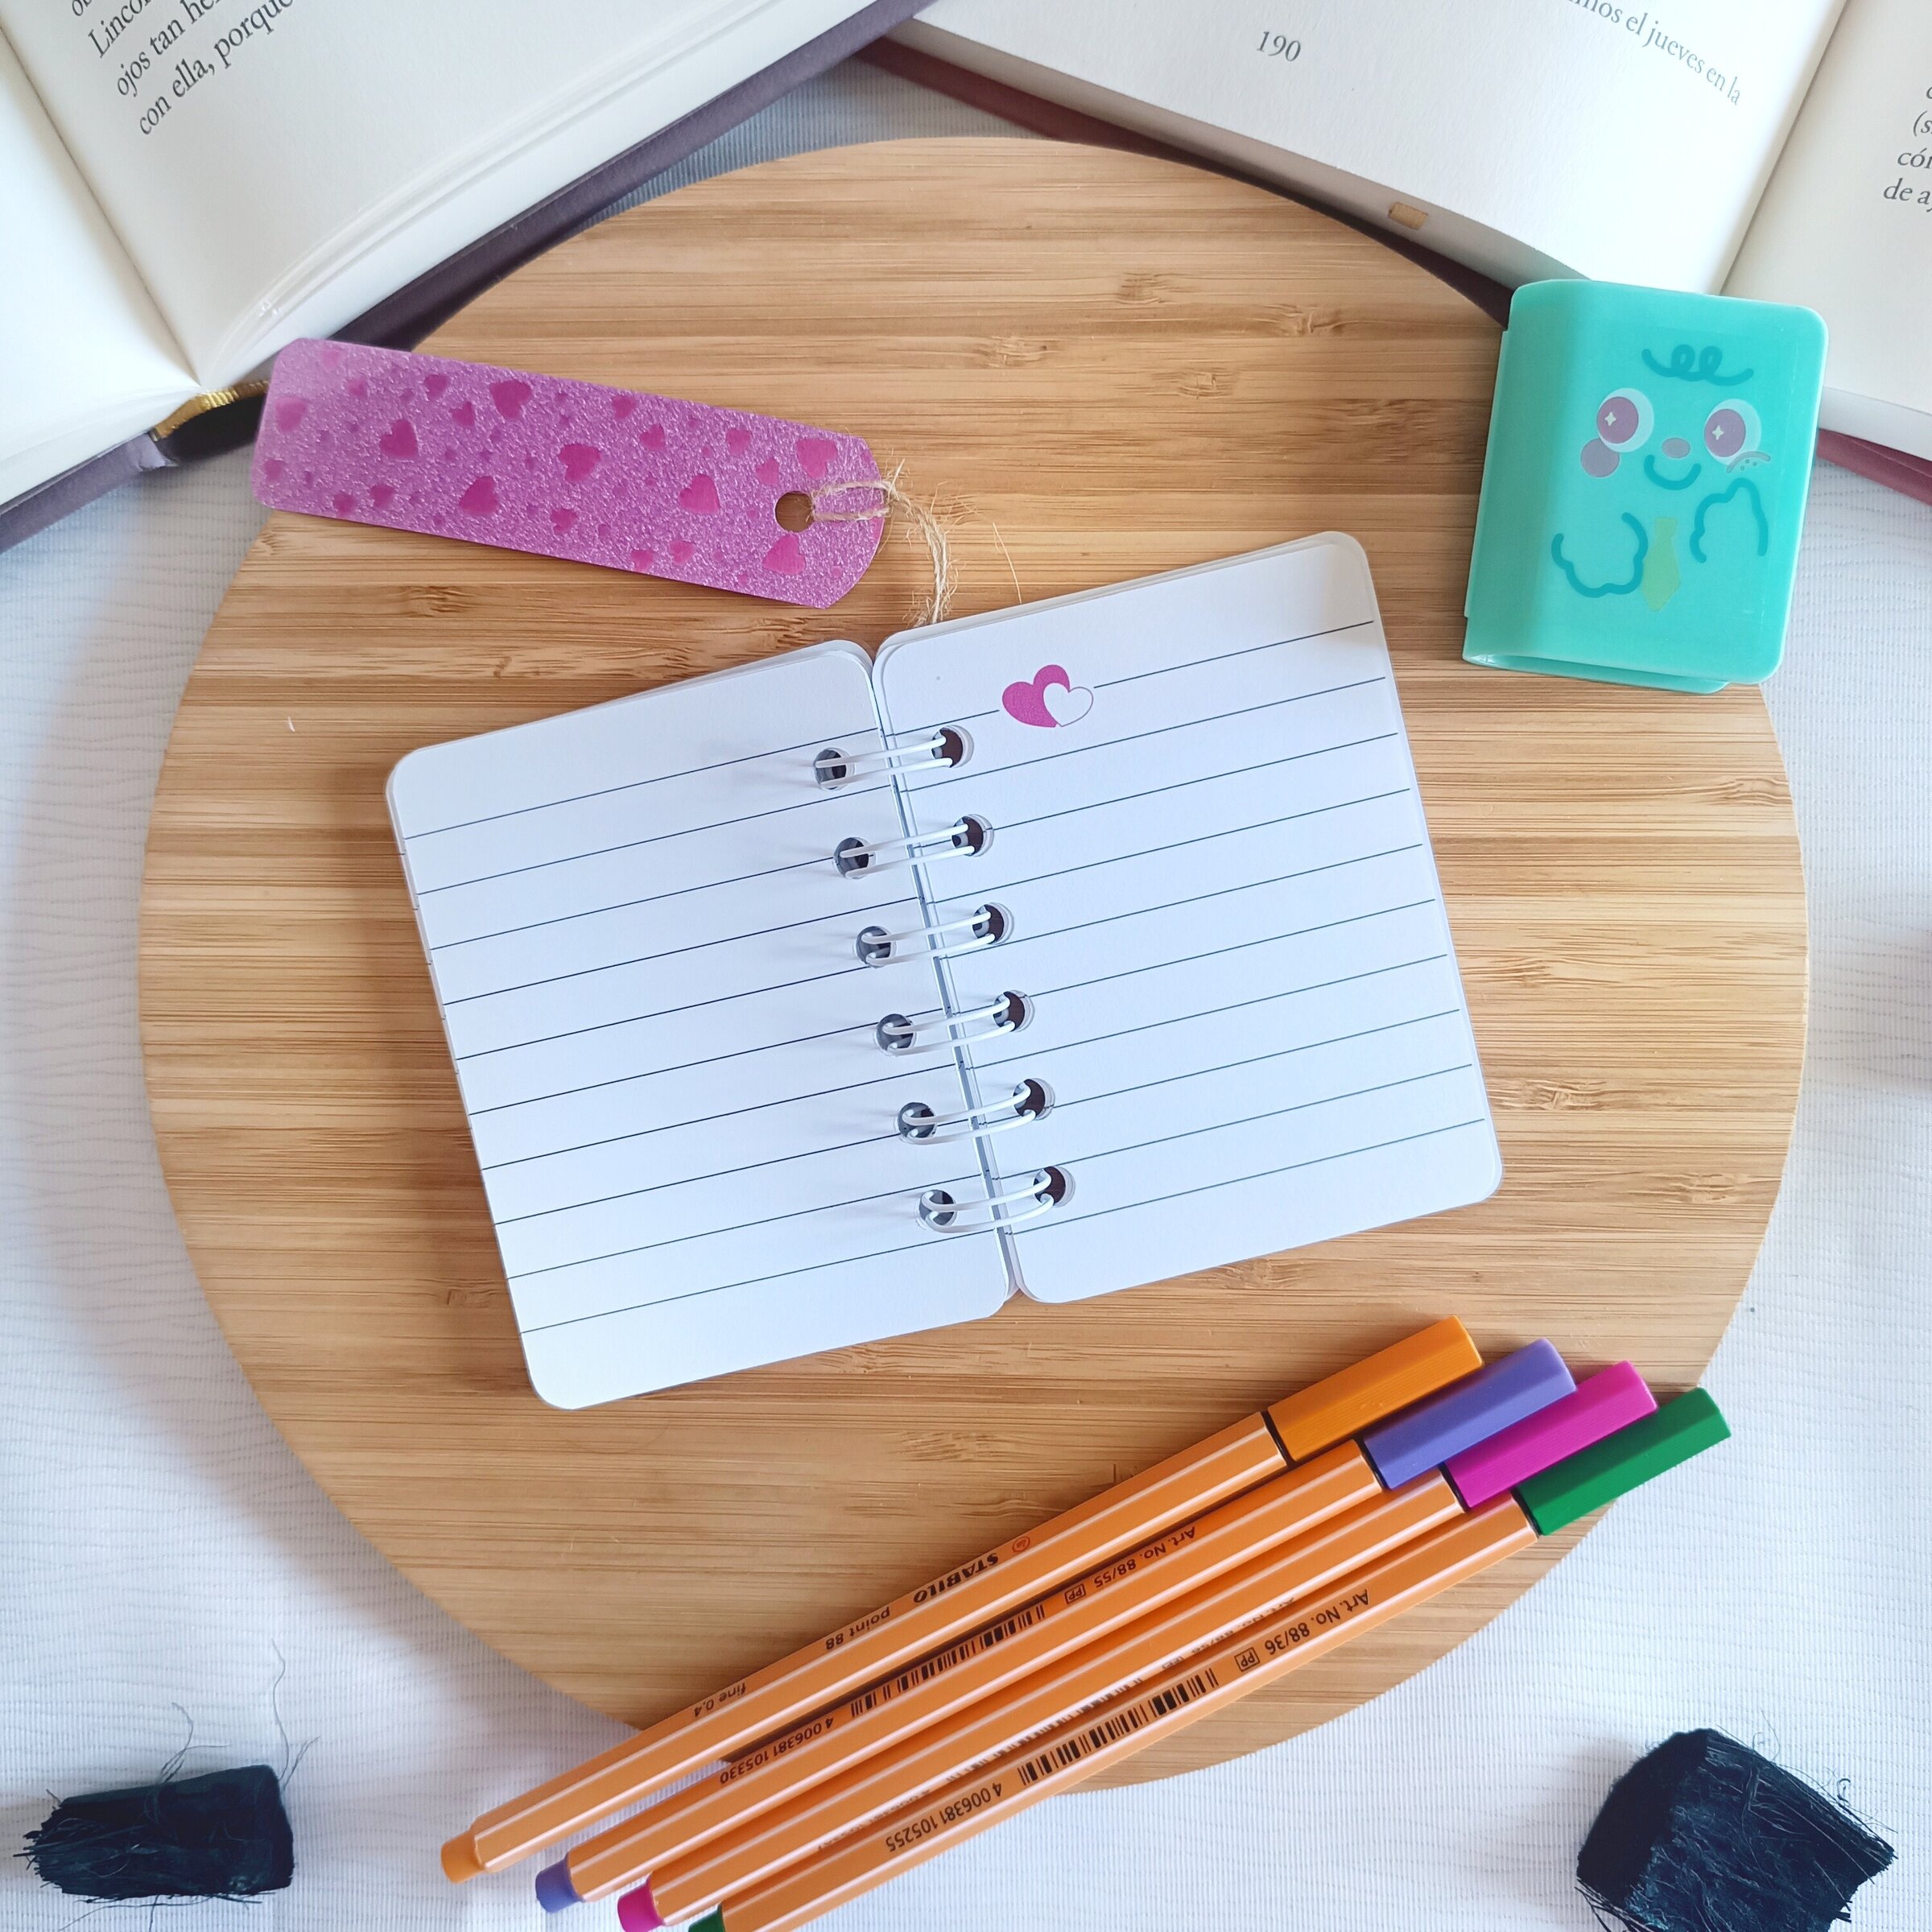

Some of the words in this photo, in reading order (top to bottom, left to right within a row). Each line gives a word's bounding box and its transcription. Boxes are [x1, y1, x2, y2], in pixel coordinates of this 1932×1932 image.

[88, 0, 151, 59] Linco
[117, 52, 151, 97] ojos
[150, 19, 186, 56] tan
[1256, 31, 1301, 62] 190
[1625, 12, 1648, 35] el
[1642, 20, 1705, 74] jueves
[1706, 67, 1726, 92] en
[1728, 76, 1740, 105] la
[139, 96, 171, 134] con
[172, 58, 215, 97] ella,
[1883, 177, 1913, 201] de
[1139, 1542, 1166, 1559] No.
[1167, 1526, 1195, 1546] Art.
[913, 1552, 999, 1604] STABILO
[1093, 1558, 1137, 1587] 88/55
[1311, 1606, 1341, 1624] No.
[1339, 1589, 1369, 1612] Art.
[848, 1605, 890, 1637] point
[825, 1633, 844, 1650] 88
[1264, 1622, 1311, 1655] 88/36
[718, 1682, 746, 1703] fine
[825, 1717, 834, 1729] 4
[772, 1723, 822, 1757] 006381
[720, 1750, 770, 1784] 105330
[992, 1782, 1002, 1798] 4
[939, 1787, 991, 1825] 006381
[886, 1815, 939, 1852] 105255
